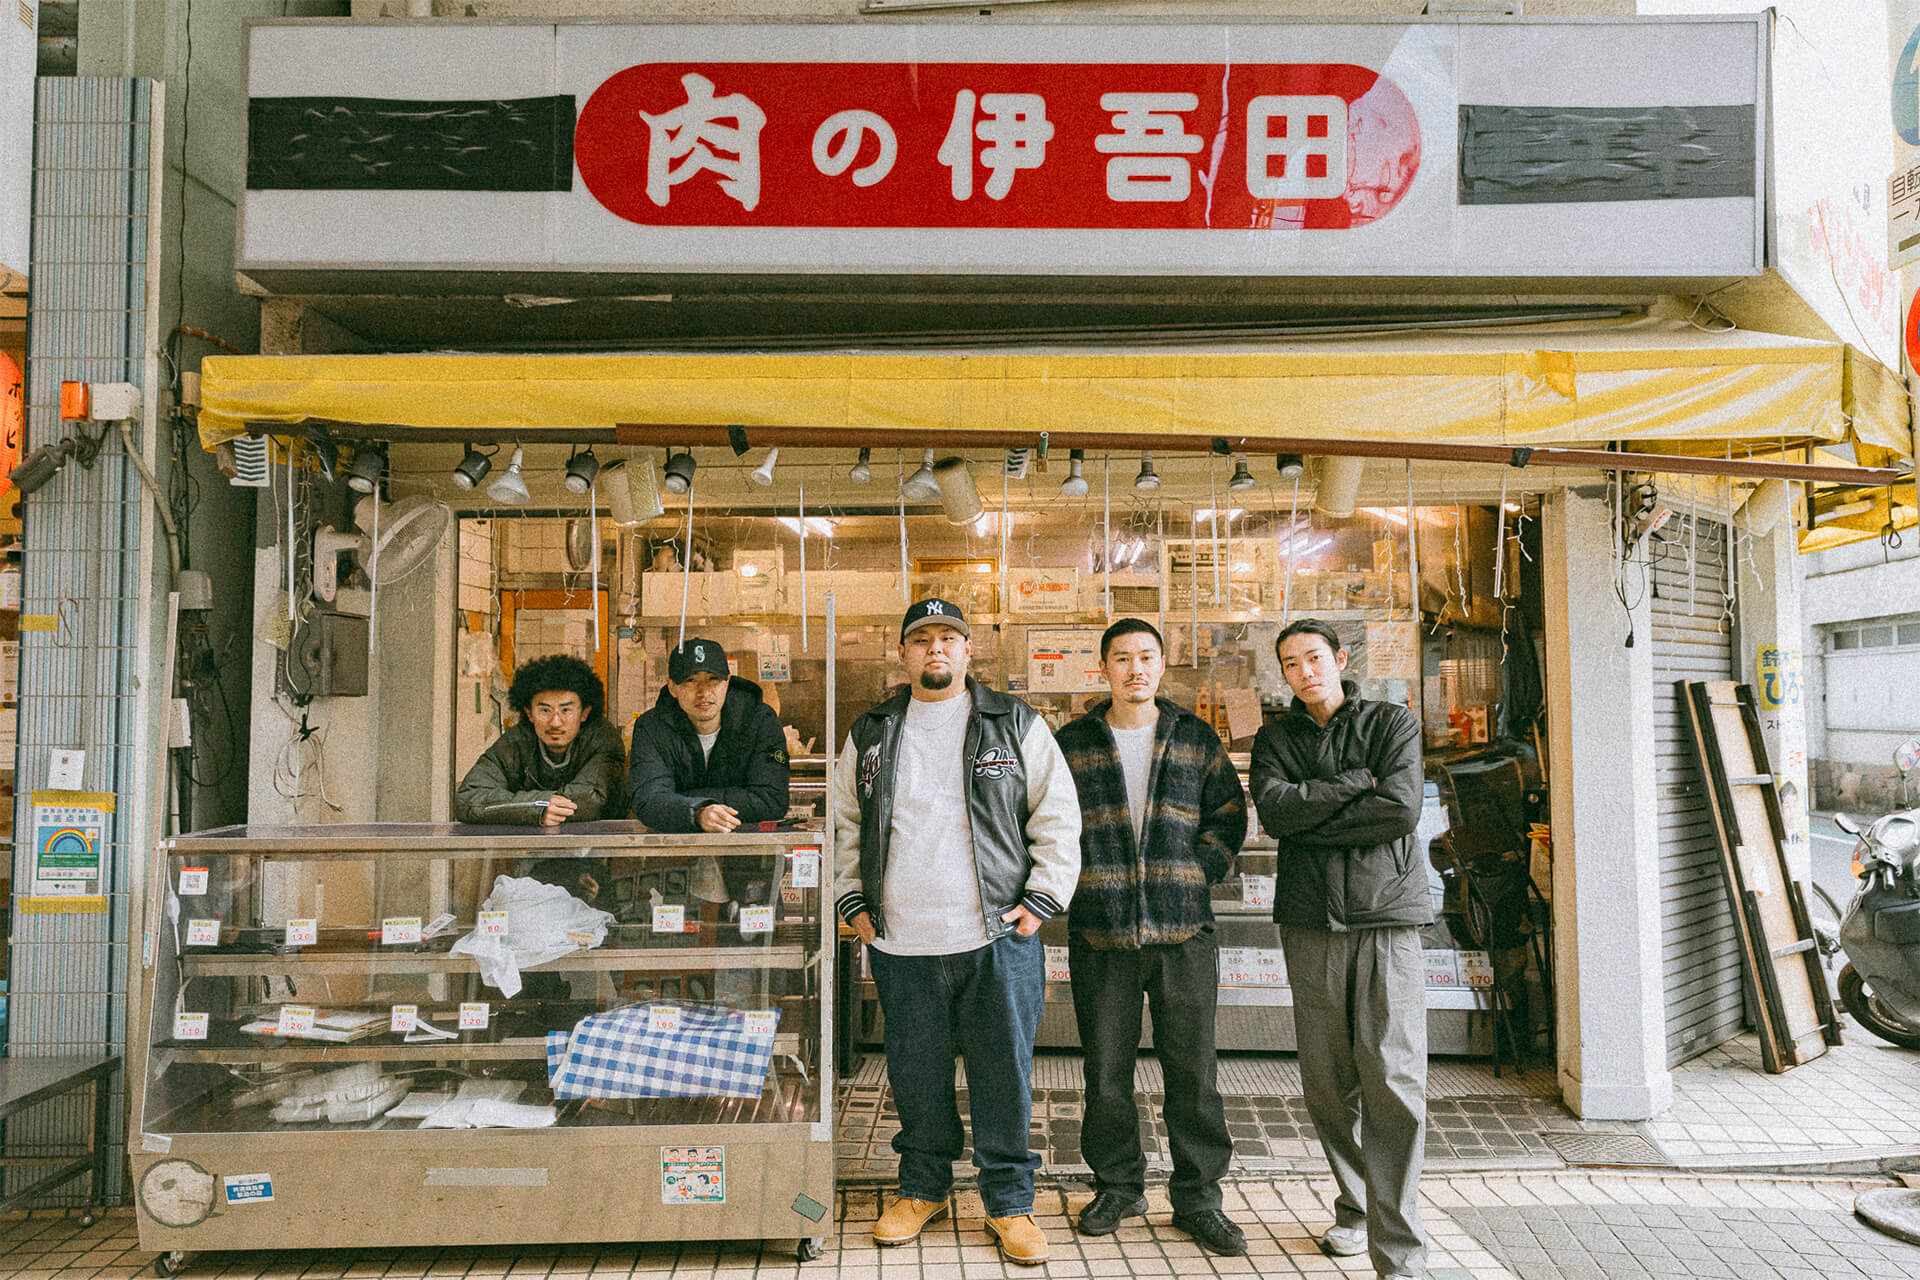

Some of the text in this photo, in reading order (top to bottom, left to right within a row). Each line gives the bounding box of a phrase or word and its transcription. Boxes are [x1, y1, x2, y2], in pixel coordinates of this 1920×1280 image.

[638, 71, 1349, 211] 肉の伊吾田
[926, 601, 943, 616] NY
[1258, 973, 1279, 982] 170
[1429, 974, 1450, 984] 100
[1469, 975, 1491, 985] 170
